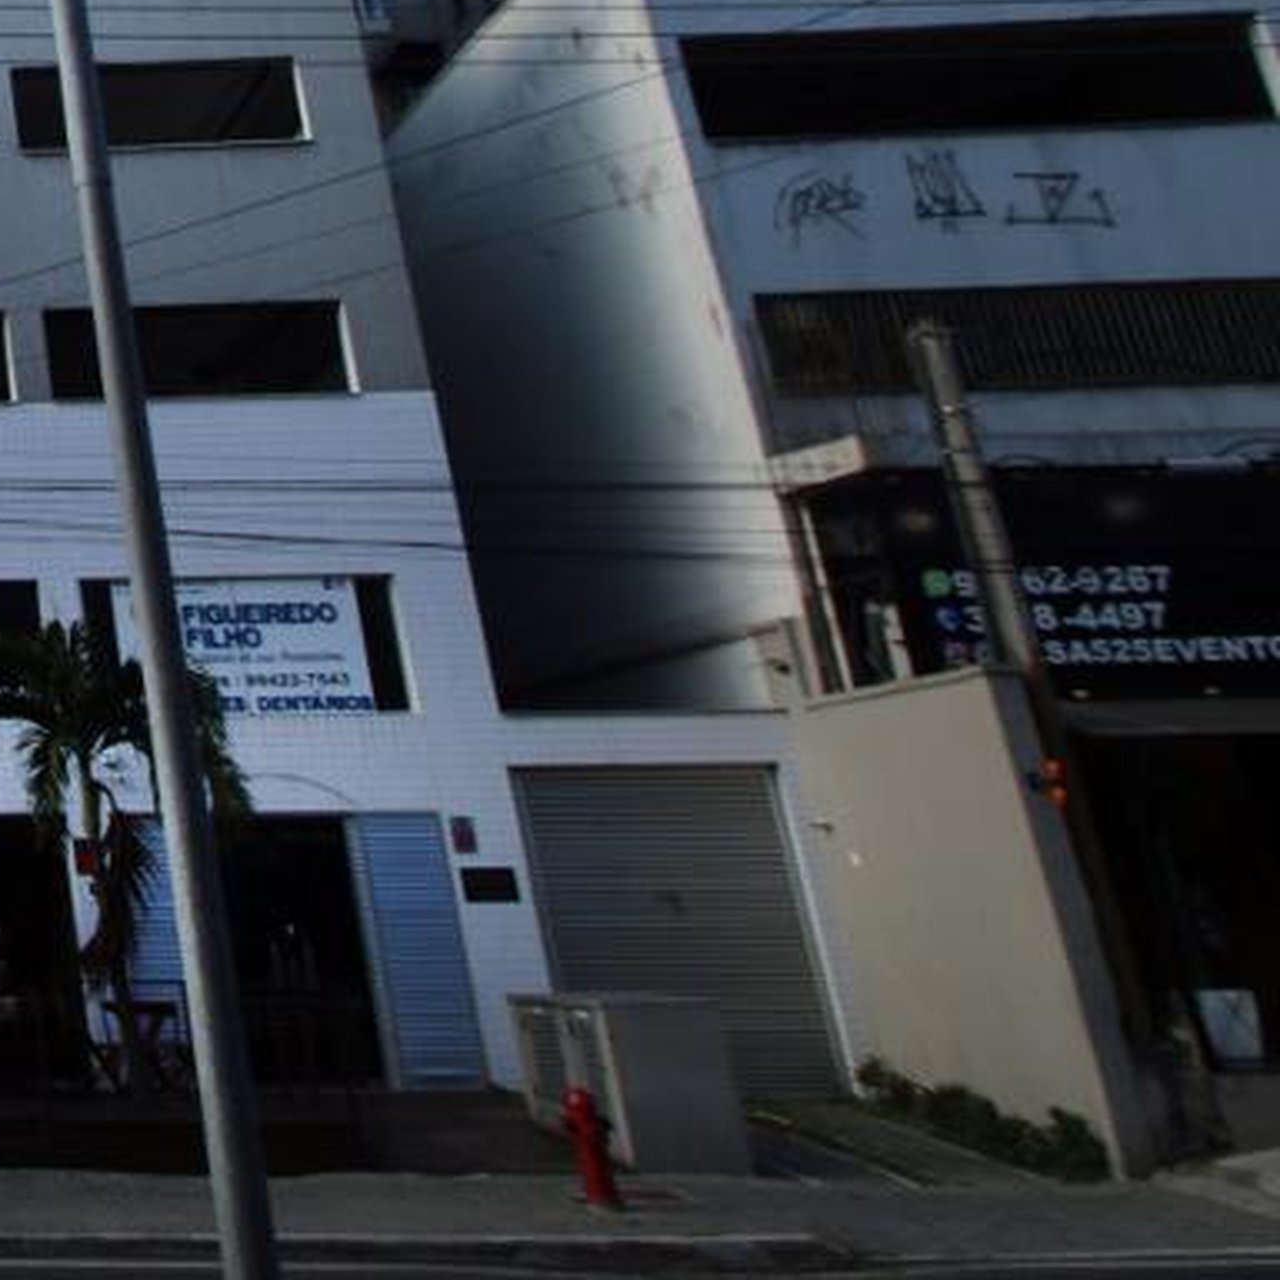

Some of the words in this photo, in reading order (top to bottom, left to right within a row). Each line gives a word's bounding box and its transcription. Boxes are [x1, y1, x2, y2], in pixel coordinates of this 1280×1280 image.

[952, 564, 1172, 597] 962-9267
[181, 601, 338, 625] FIGUEIREDO
[964, 602, 1168, 632] 38-4497
[186, 627, 262, 649] FILHO
